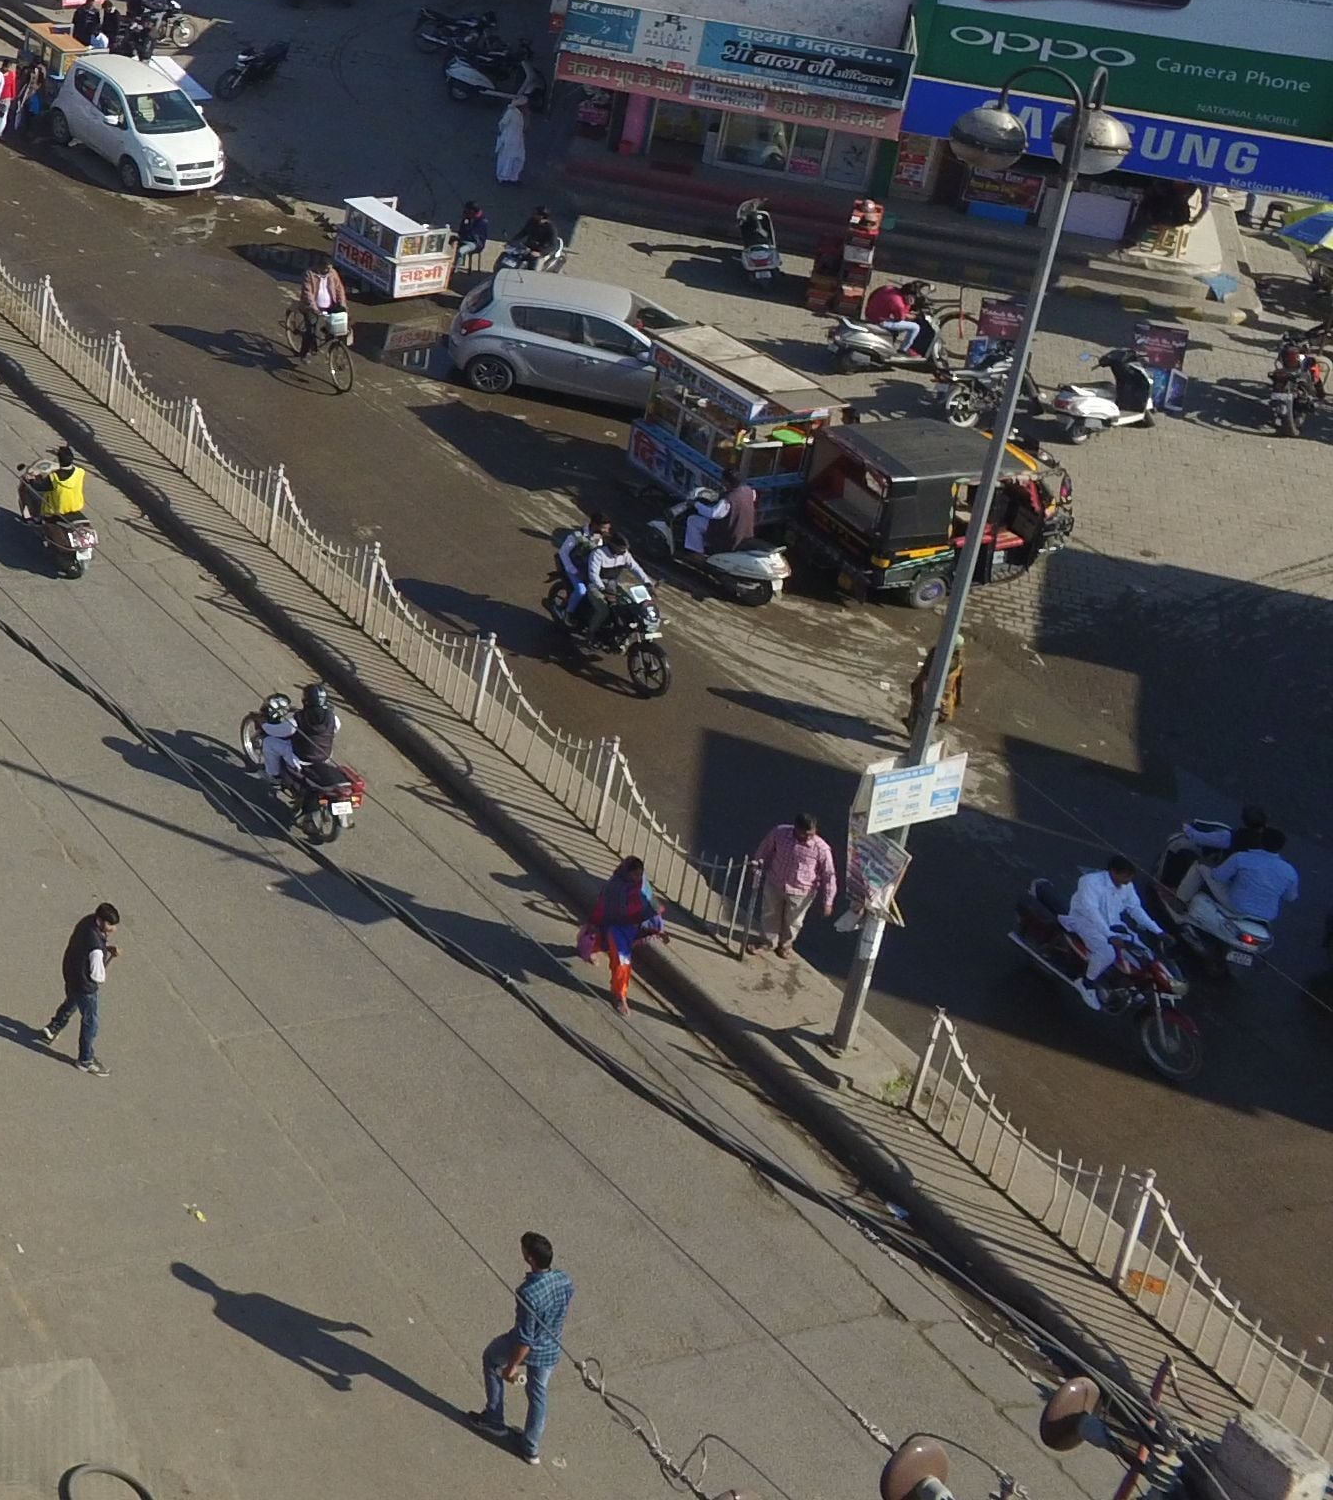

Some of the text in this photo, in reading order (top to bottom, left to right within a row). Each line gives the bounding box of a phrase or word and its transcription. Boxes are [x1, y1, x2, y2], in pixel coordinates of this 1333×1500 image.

[1155, 56, 1237, 82] Camera
[1245, 70, 1312, 94] Phone
[1197, 103, 1300, 127] NATIONAL MOBILE
[1229, 177, 1285, 193] National
